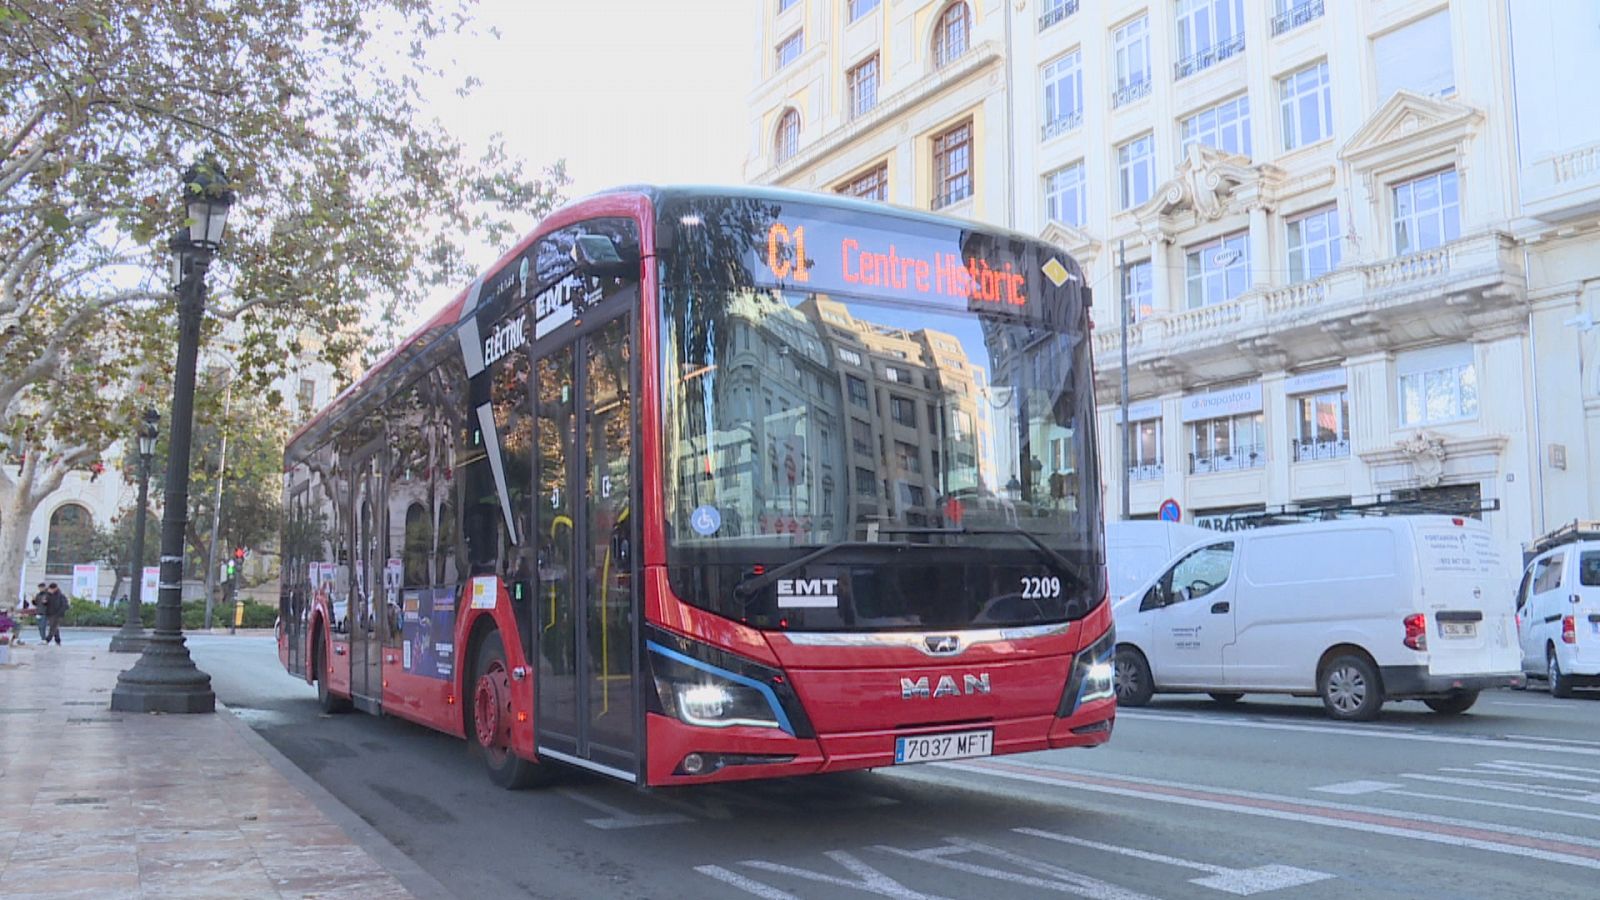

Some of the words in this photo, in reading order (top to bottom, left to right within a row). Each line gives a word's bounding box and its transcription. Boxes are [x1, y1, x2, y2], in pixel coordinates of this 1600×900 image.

[767, 221, 810, 283] C1
[841, 238, 931, 293] Centre
[934, 251, 1027, 306] Històric
[536, 275, 573, 319] EMT
[484, 314, 527, 366] ELÈCTRIC
[777, 579, 838, 595] EMT
[1020, 576, 1061, 600] 2209
[900, 673, 991, 700] MAN
[908, 736, 952, 760] 7037
[957, 733, 989, 756] MFT
